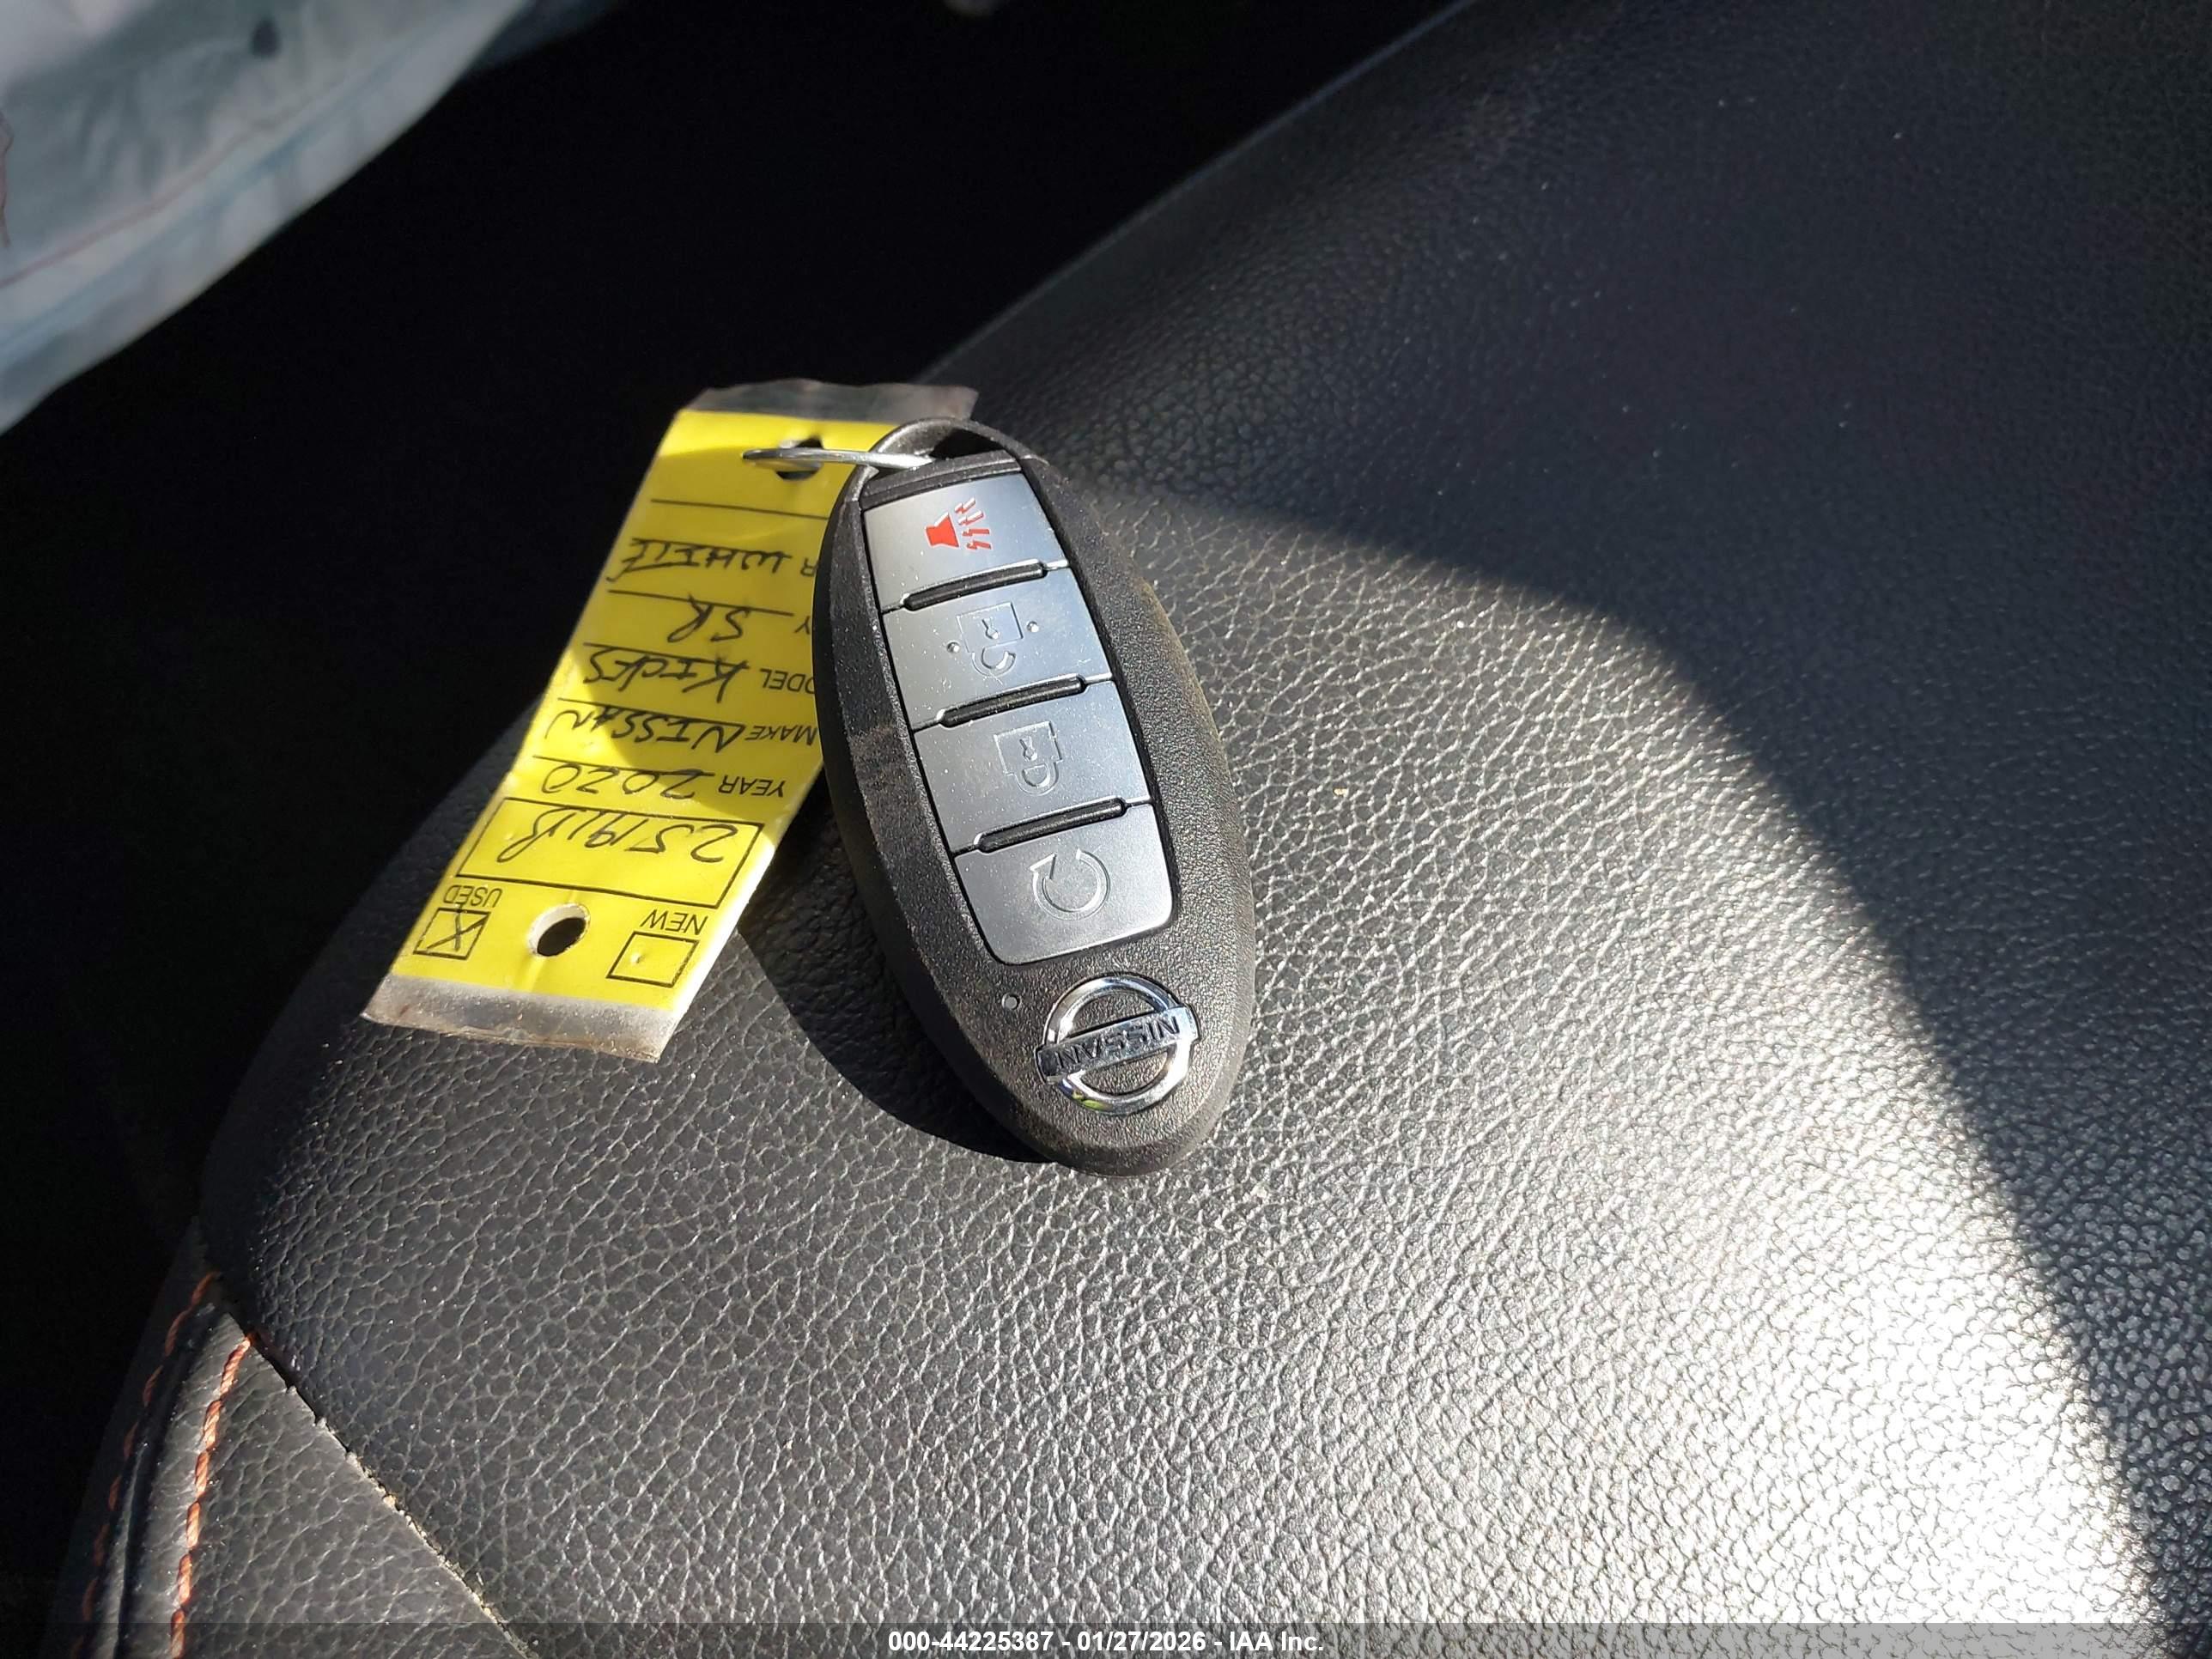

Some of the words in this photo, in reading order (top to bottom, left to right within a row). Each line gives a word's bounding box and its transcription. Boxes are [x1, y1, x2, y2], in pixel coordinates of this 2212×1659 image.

[667, 596, 750, 642] SR
[760, 668, 815, 694] ODEL
[545, 706, 745, 753] NISSAN
[744, 726, 818, 746] MAKE
[541, 763, 705, 799] 2020
[718, 775, 786, 798] YEAR
[443, 884, 503, 908] USED
[640, 908, 708, 935] NEW
[1054, 1015, 1181, 1070] NISSAN
